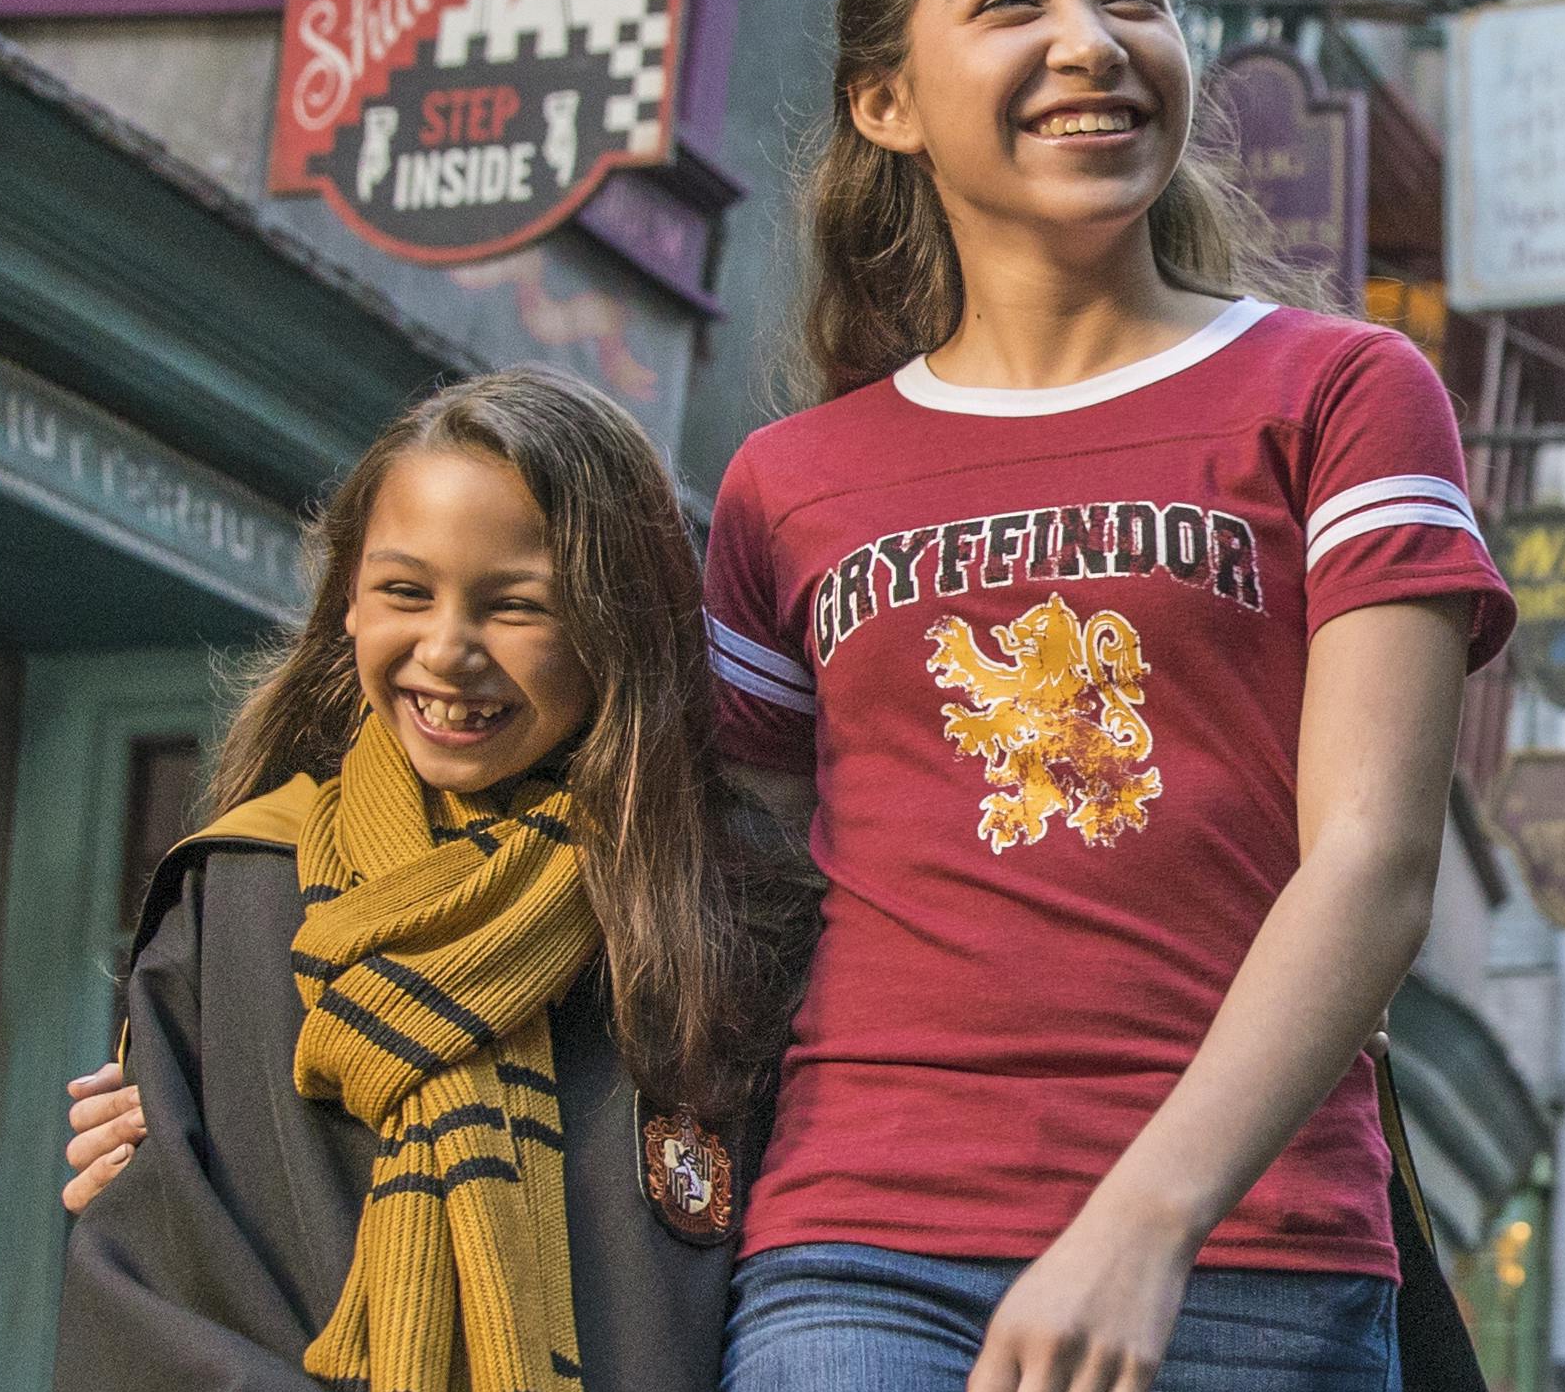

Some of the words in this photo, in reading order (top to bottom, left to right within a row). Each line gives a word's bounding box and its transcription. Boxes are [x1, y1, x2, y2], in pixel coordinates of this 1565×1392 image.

[420, 89, 520, 145] STEP
[393, 143, 536, 211] INSIDE
[813, 500, 1266, 667] GRYFFINDOR
